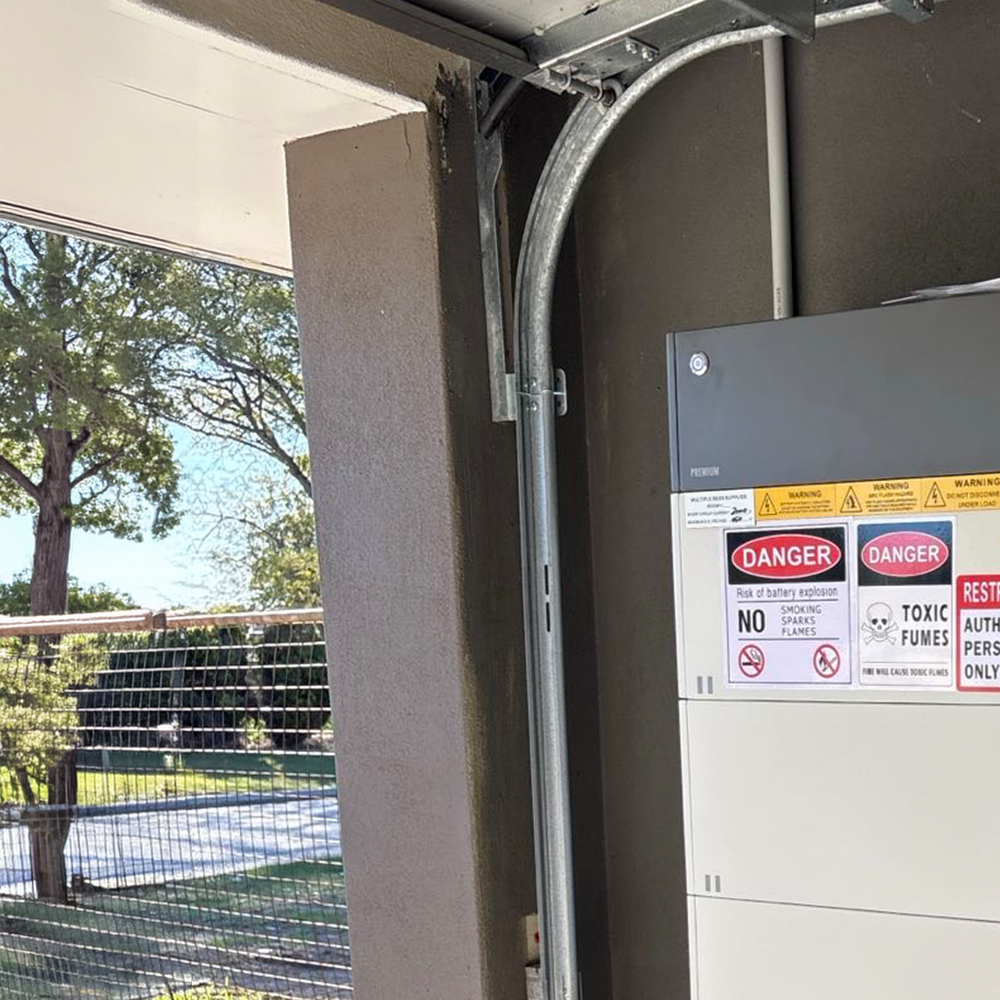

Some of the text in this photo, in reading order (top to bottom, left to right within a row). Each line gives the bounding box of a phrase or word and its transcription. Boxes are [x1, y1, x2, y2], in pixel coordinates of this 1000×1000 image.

[690, 467, 719, 477] PREMIUM
[873, 482, 910, 493] WARNING
[954, 478, 1000, 488] WARNING
[788, 490, 822, 499] WARNING
[743, 545, 832, 568] DANGER
[868, 545, 940, 563] DANGER
[737, 586, 839, 601] Risk of battery explosion
[781, 604, 822, 615] SMOKING
[902, 604, 948, 622] TOXIC
[738, 608, 765, 633] NO
[781, 615, 816, 626] SPARKS
[782, 627, 817, 636] FLAMES
[902, 629, 949, 646] FUMES
[876, 667, 889, 675] WILL
[890, 667, 909, 676] CAUSE
[910, 668, 927, 676] TOXIC
[929, 668, 949, 676] FUMES
[964, 664, 1000, 679] ONLY
